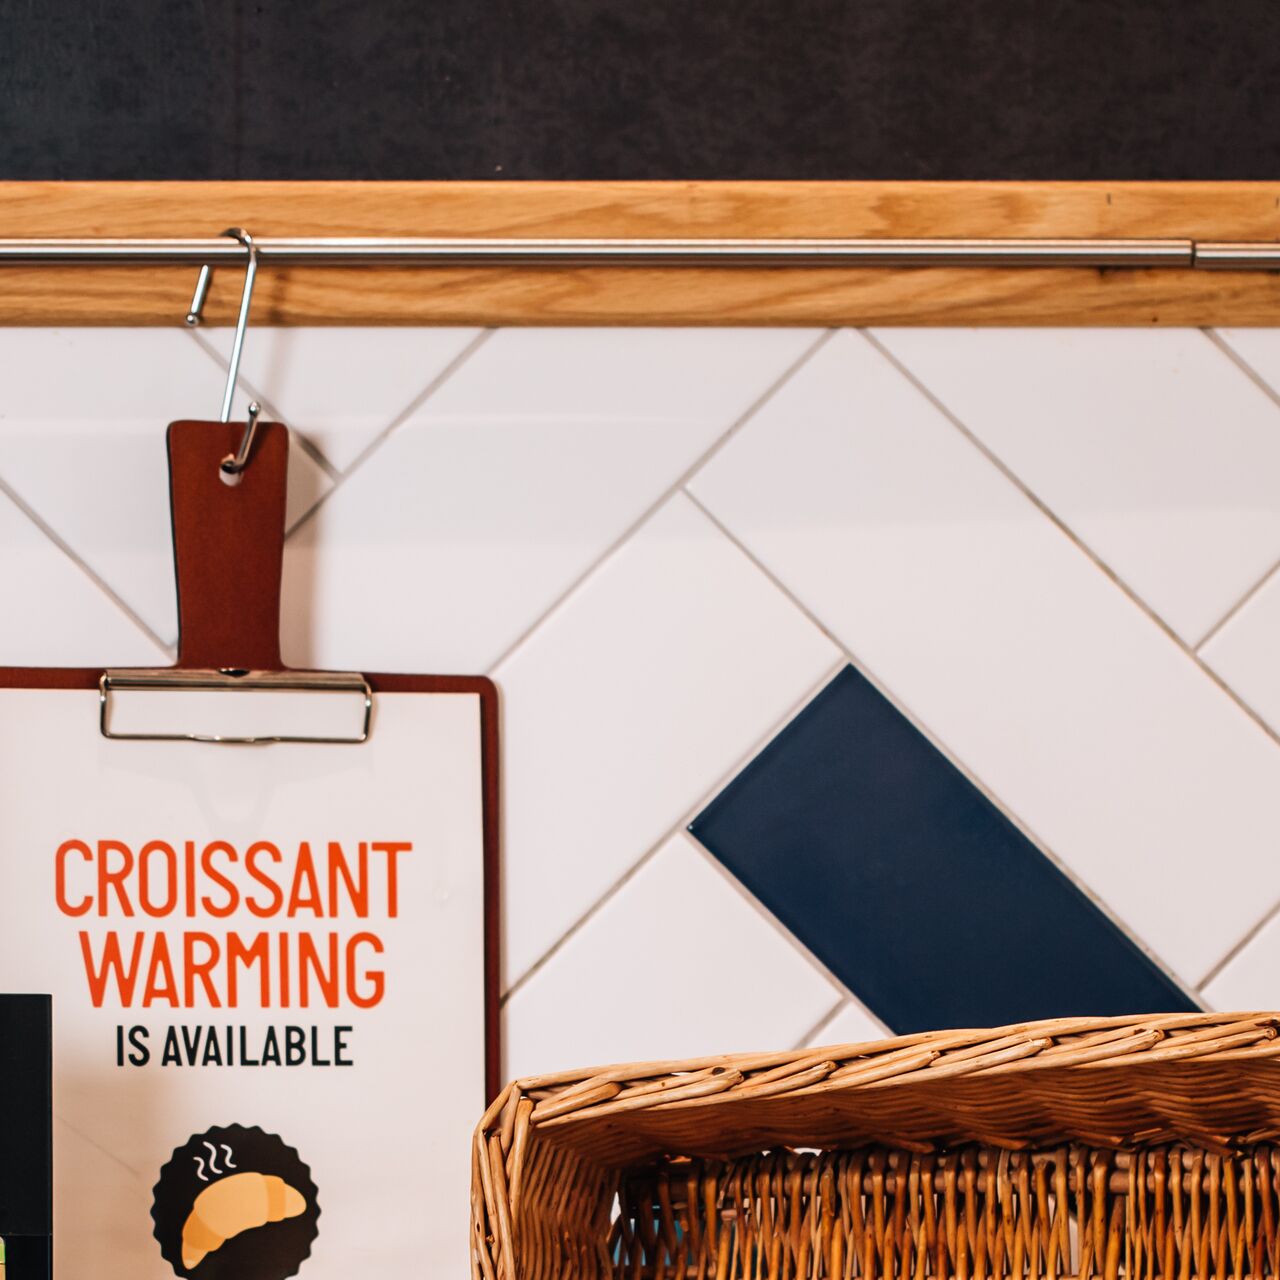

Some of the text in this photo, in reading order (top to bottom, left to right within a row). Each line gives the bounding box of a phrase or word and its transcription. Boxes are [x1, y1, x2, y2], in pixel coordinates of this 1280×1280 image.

[55, 839, 413, 919] CROISSANT
[78, 931, 386, 1009] WARMING
[117, 1025, 354, 1067] IS AVAILABLE
